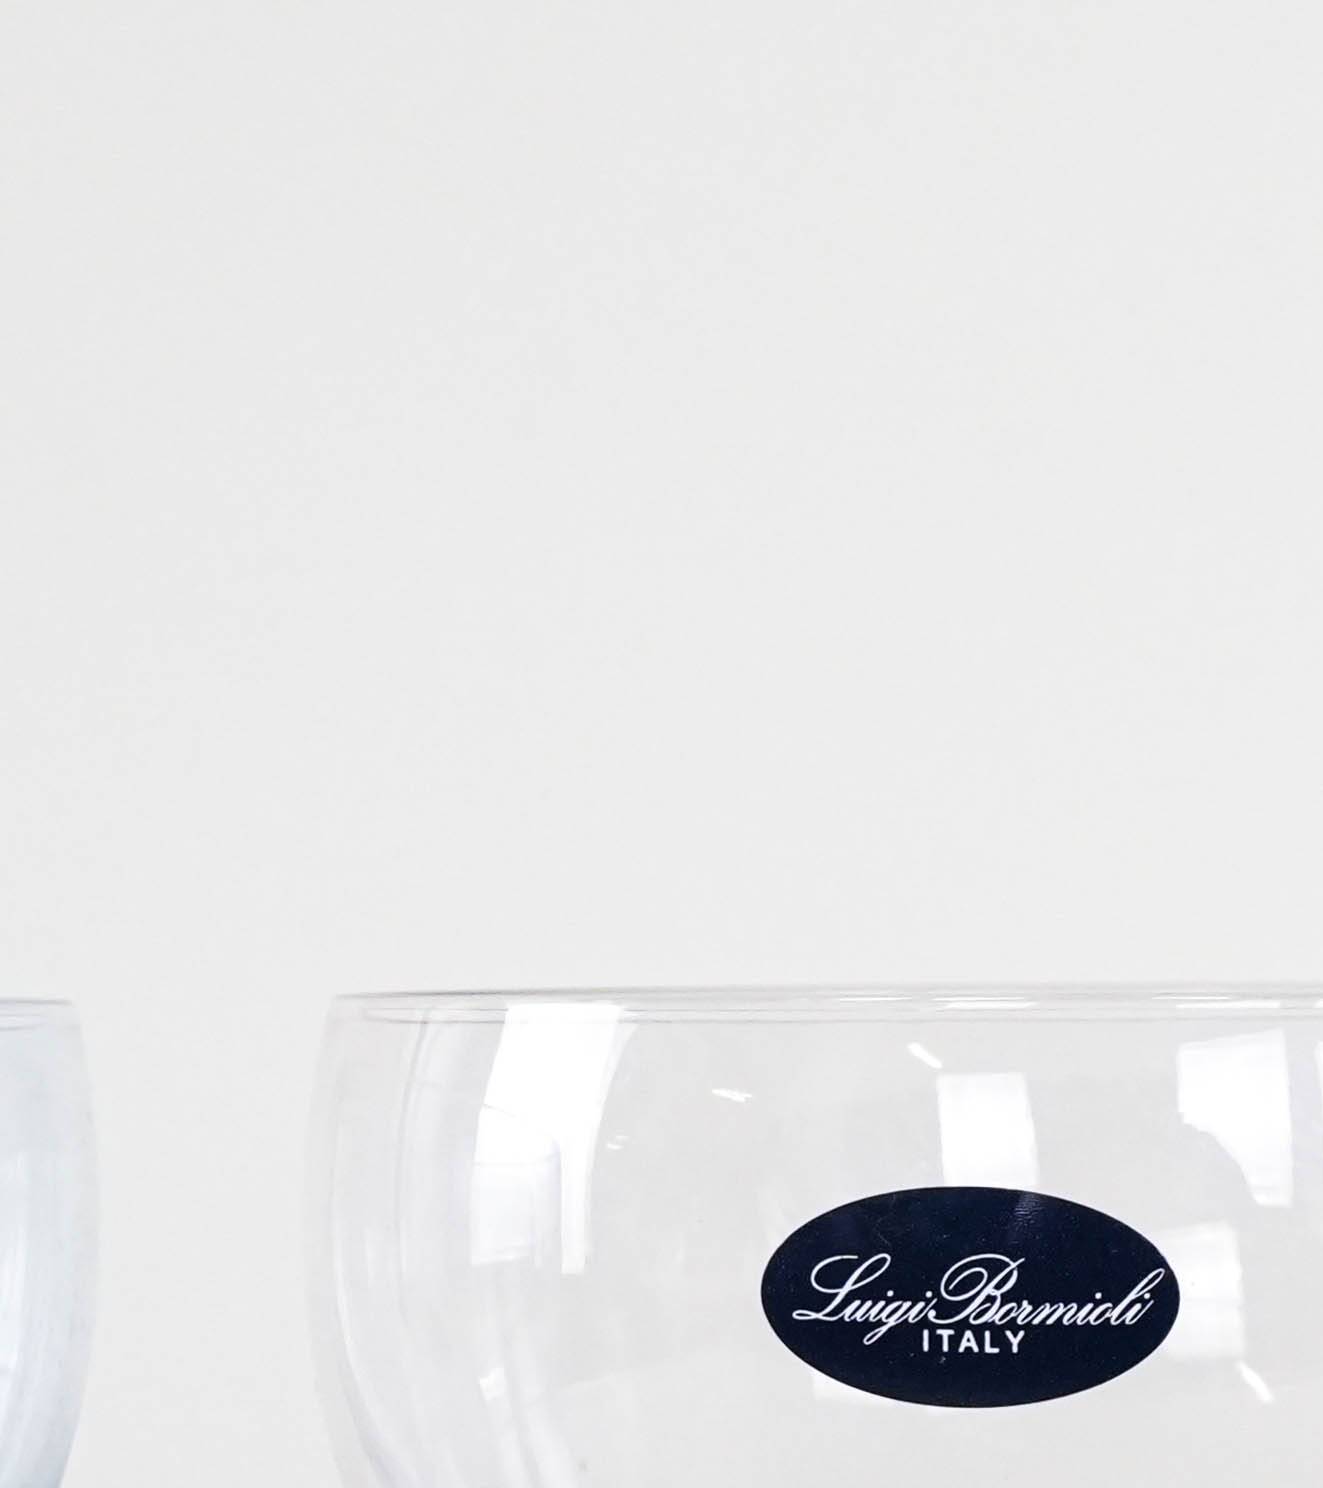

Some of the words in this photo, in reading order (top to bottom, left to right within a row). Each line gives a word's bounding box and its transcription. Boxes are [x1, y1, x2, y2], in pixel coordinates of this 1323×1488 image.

[793, 1253, 938, 1345] Luigi
[928, 1253, 1165, 1326] Bormioli
[922, 1328, 1025, 1353] ITALY
